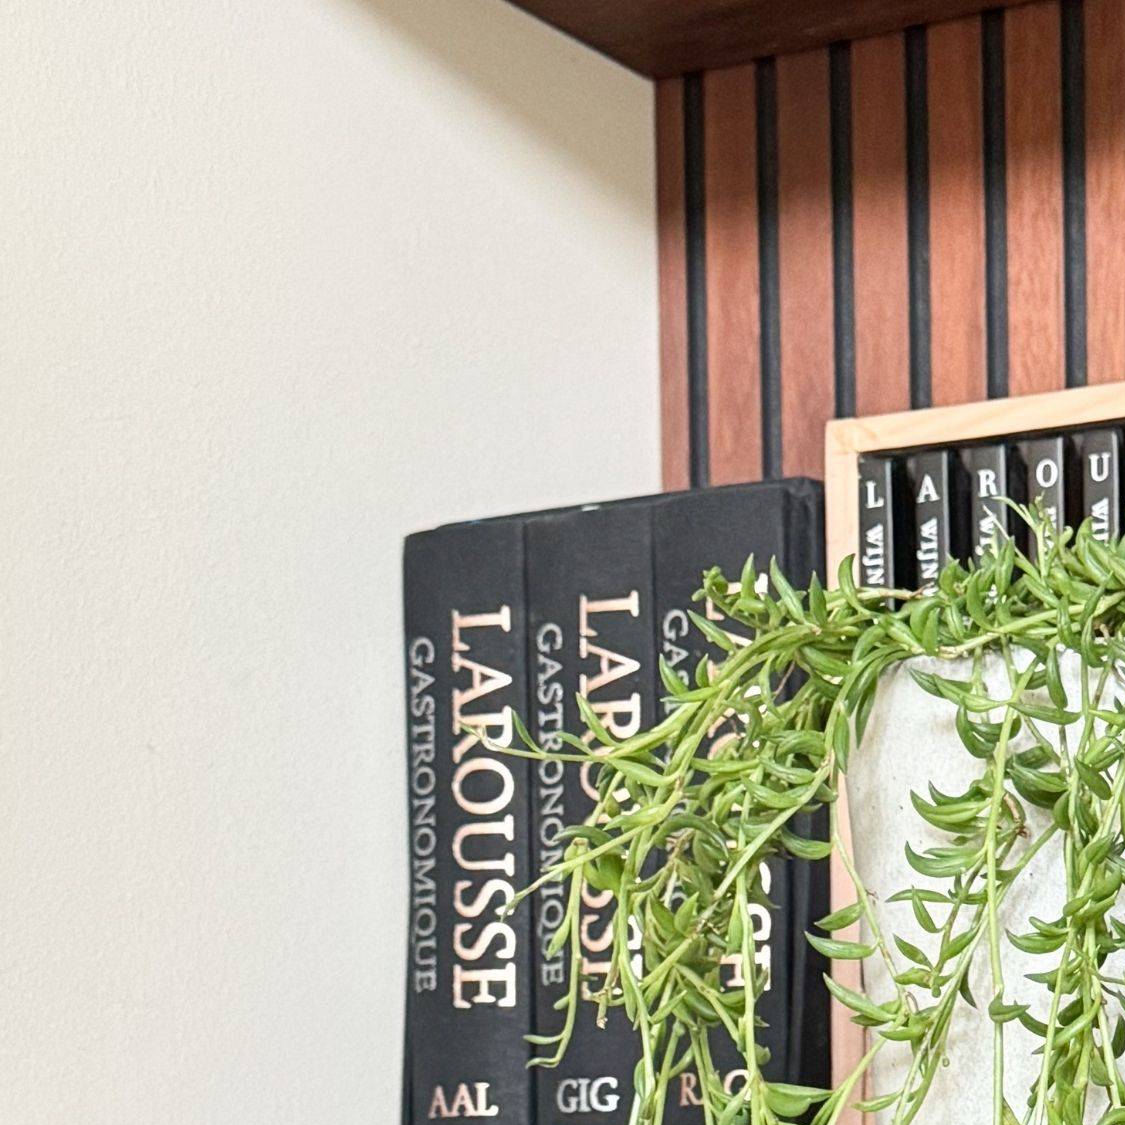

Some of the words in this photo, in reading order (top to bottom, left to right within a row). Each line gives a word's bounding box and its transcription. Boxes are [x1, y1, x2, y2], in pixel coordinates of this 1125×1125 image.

[409, 636, 437, 994] GASTRONOMIQUE
[451, 604, 517, 1010] LAROUSSE
[428, 1081, 499, 1119] AAL
[556, 1076, 621, 1114] GIG
